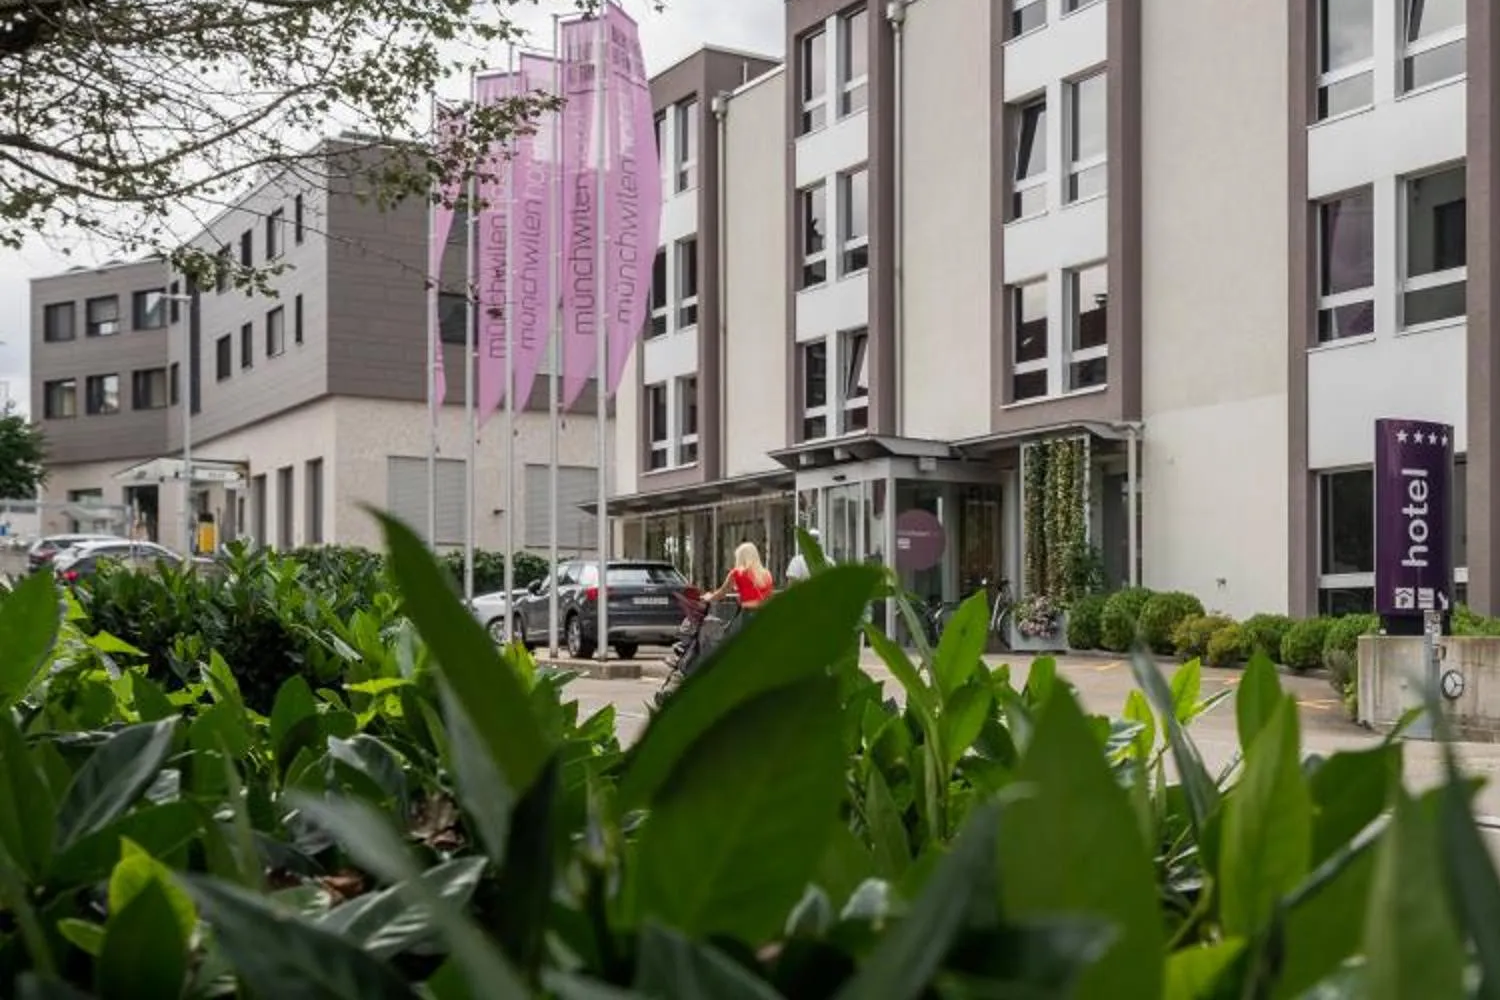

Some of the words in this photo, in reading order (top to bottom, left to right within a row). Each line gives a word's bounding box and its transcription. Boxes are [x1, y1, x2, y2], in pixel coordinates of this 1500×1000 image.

[486, 213, 507, 359] müchwilen
[569, 174, 595, 335] münchwilen
[614, 156, 639, 324] münchwilen
[1401, 468, 1429, 567] hotel
